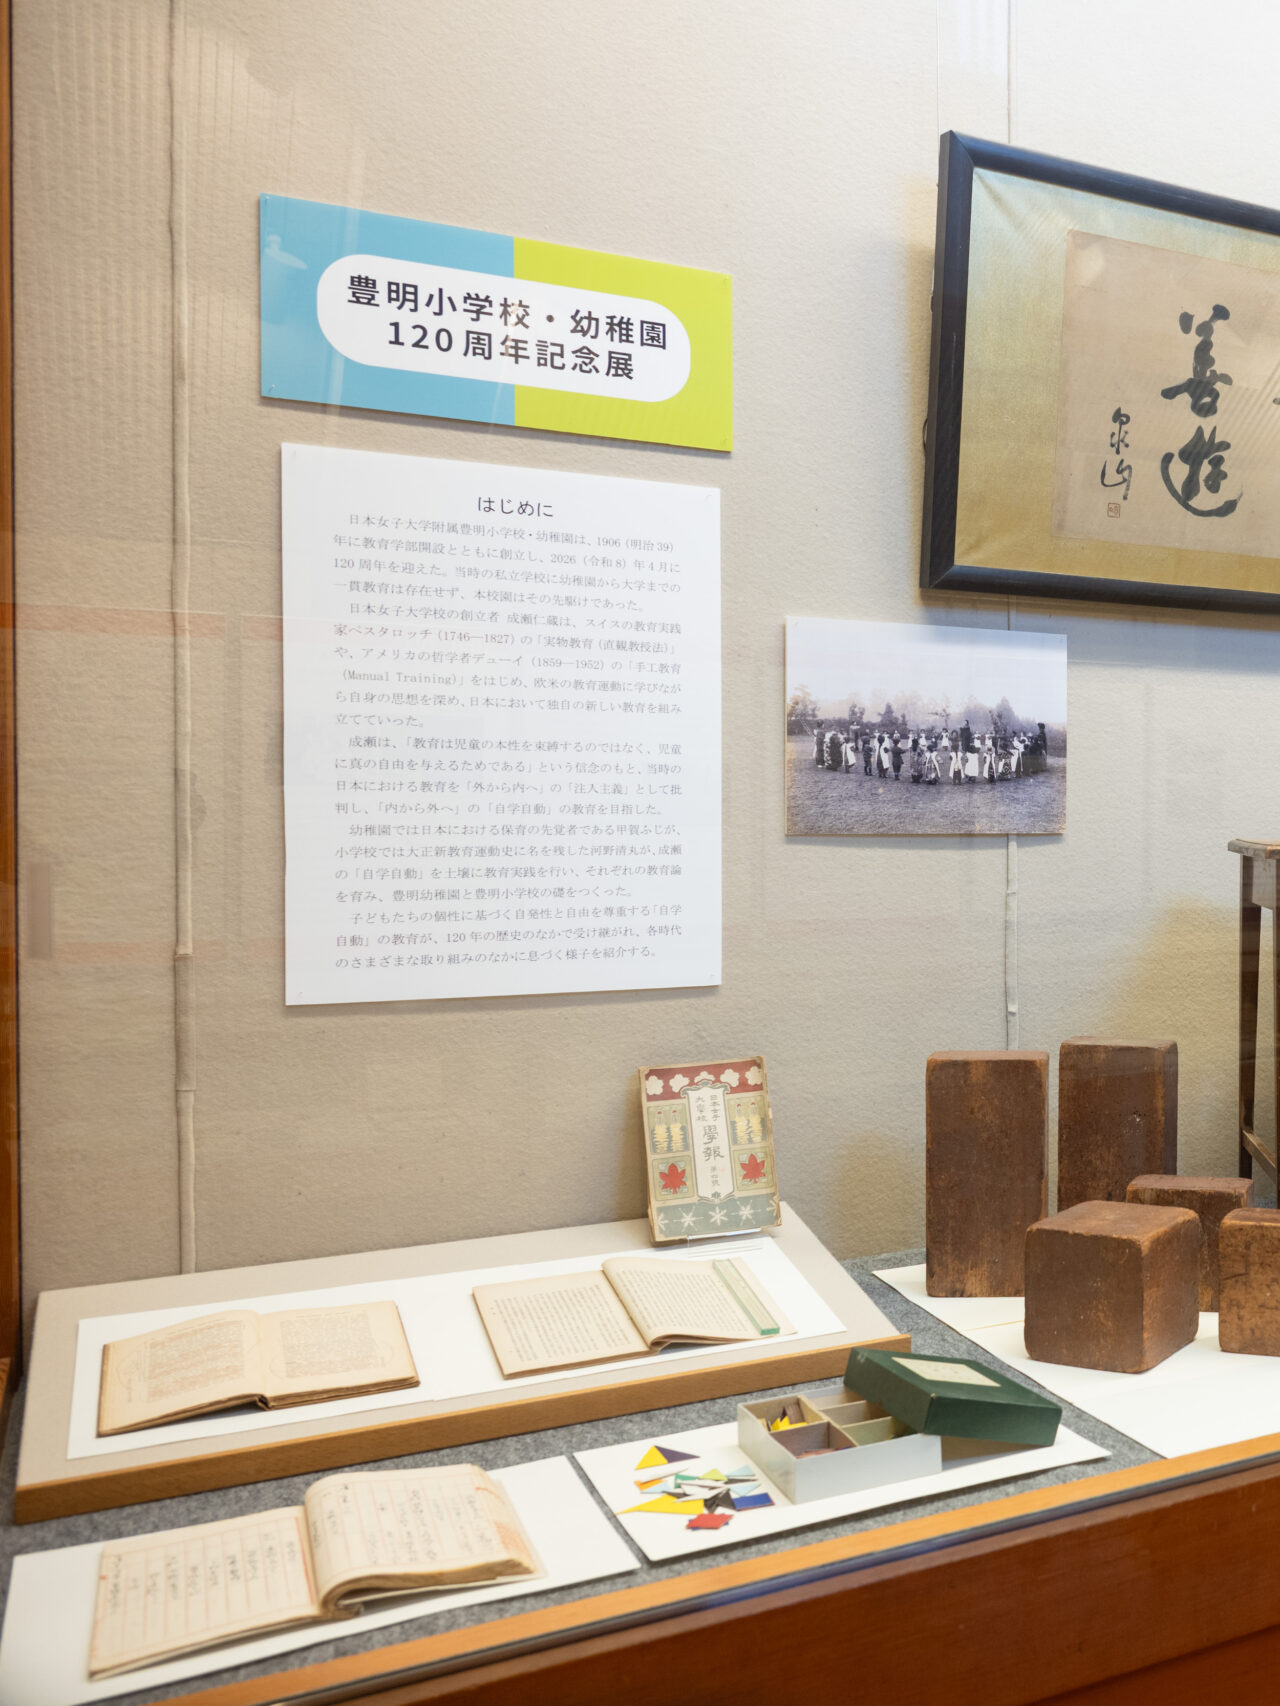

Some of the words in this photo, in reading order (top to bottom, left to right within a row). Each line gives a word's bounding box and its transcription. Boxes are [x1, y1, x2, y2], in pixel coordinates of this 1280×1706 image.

[347, 274, 667, 350] 豊明小学校・幼稚園
[388, 321, 635, 380] 120周年記念展
[477, 496, 554, 518] はじめに
